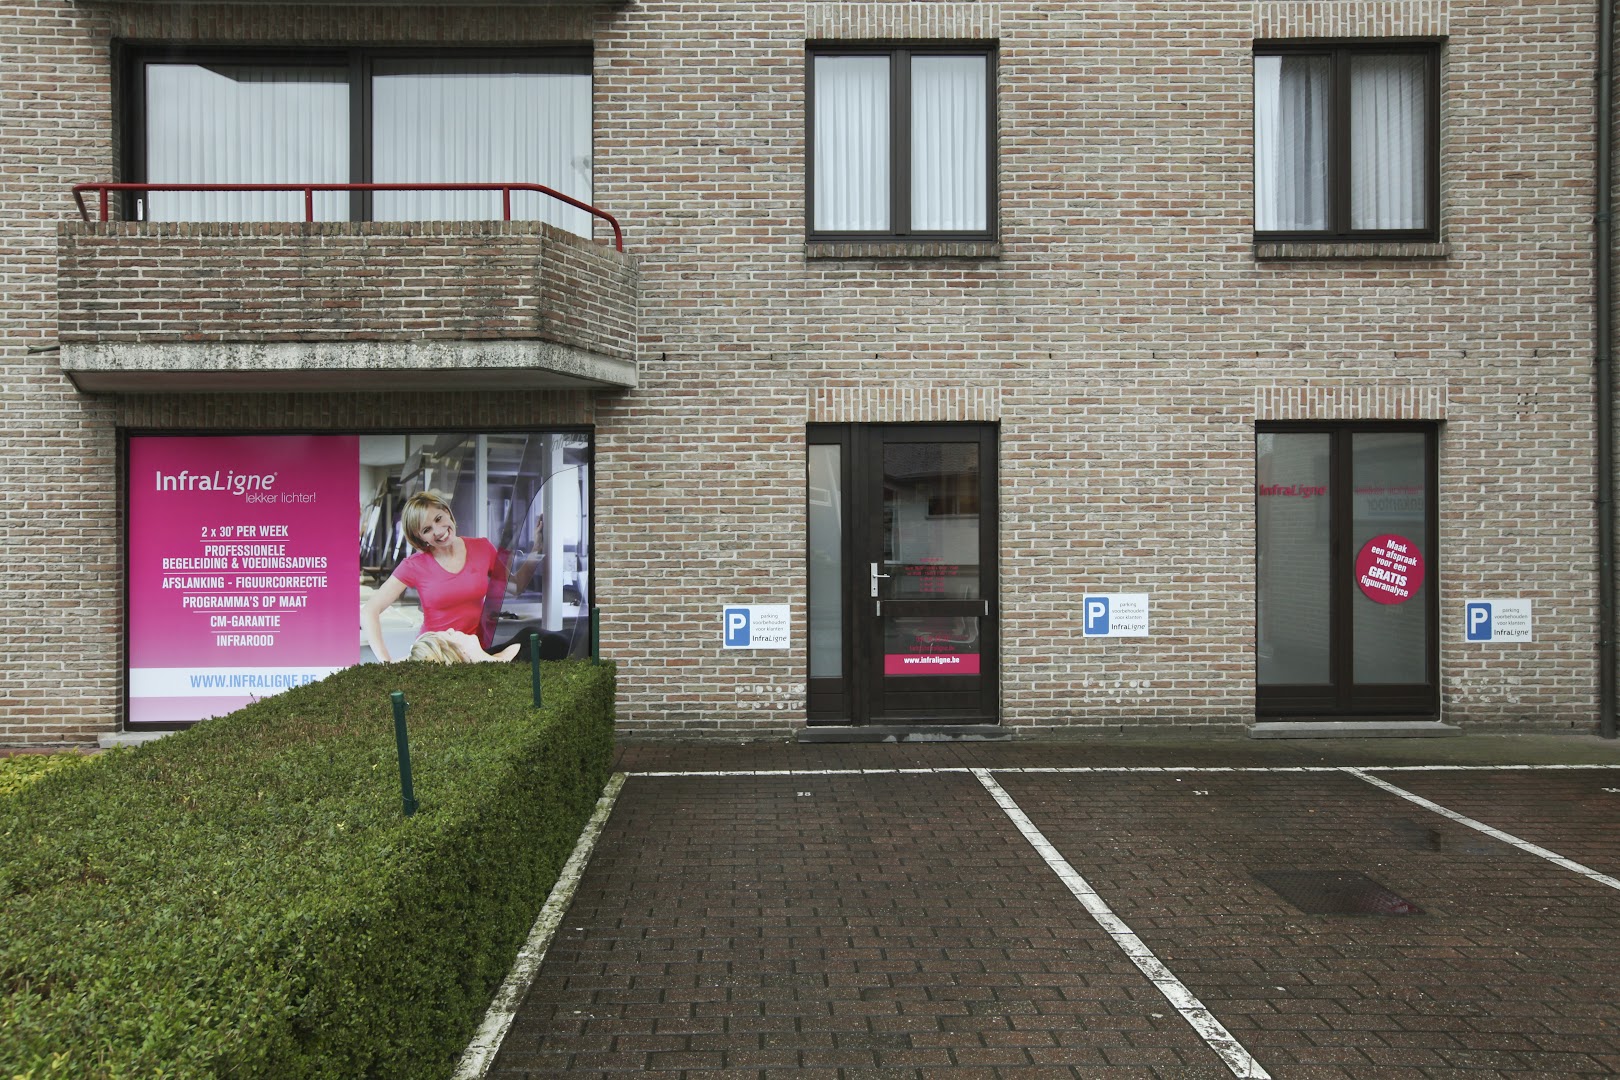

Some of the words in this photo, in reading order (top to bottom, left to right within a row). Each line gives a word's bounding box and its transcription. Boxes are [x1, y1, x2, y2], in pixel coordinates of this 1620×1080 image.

[245, 493, 278, 504] lekker
[281, 492, 316, 503] lichter!
[201, 526, 208, 538] 2
[211, 528, 217, 537] x
[236, 526, 257, 537] PER
[259, 525, 289, 537] WEEK
[204, 545, 286, 557] PROFESSIONELE
[1386, 539, 1408, 554] Maak
[1371, 545, 1385, 556] een
[1385, 550, 1418, 567] afspraak
[162, 558, 228, 570] BEGELEIDING
[231, 558, 240, 569] &
[242, 557, 328, 570] VOEDINGSADVIES
[1376, 557, 1393, 568] voor
[1393, 562, 1407, 573] een
[162, 577, 225, 589] AFSLANKING
[235, 576, 328, 588] FIGUURCORRECTIE
[1368, 565, 1408, 587] GRATIS
[1360, 574, 1409, 598] figuuranalyse
[262, 596, 277, 607] OP
[279, 595, 308, 607] MAAT
[210, 615, 281, 627] CM-GARANTIE
[216, 635, 274, 647] INFRAROOD
[752, 635, 787, 643] InfraLigne
[903, 655, 960, 665] www.infraligne.be
[190, 674, 317, 688] WWW.INFRALIGNEB
